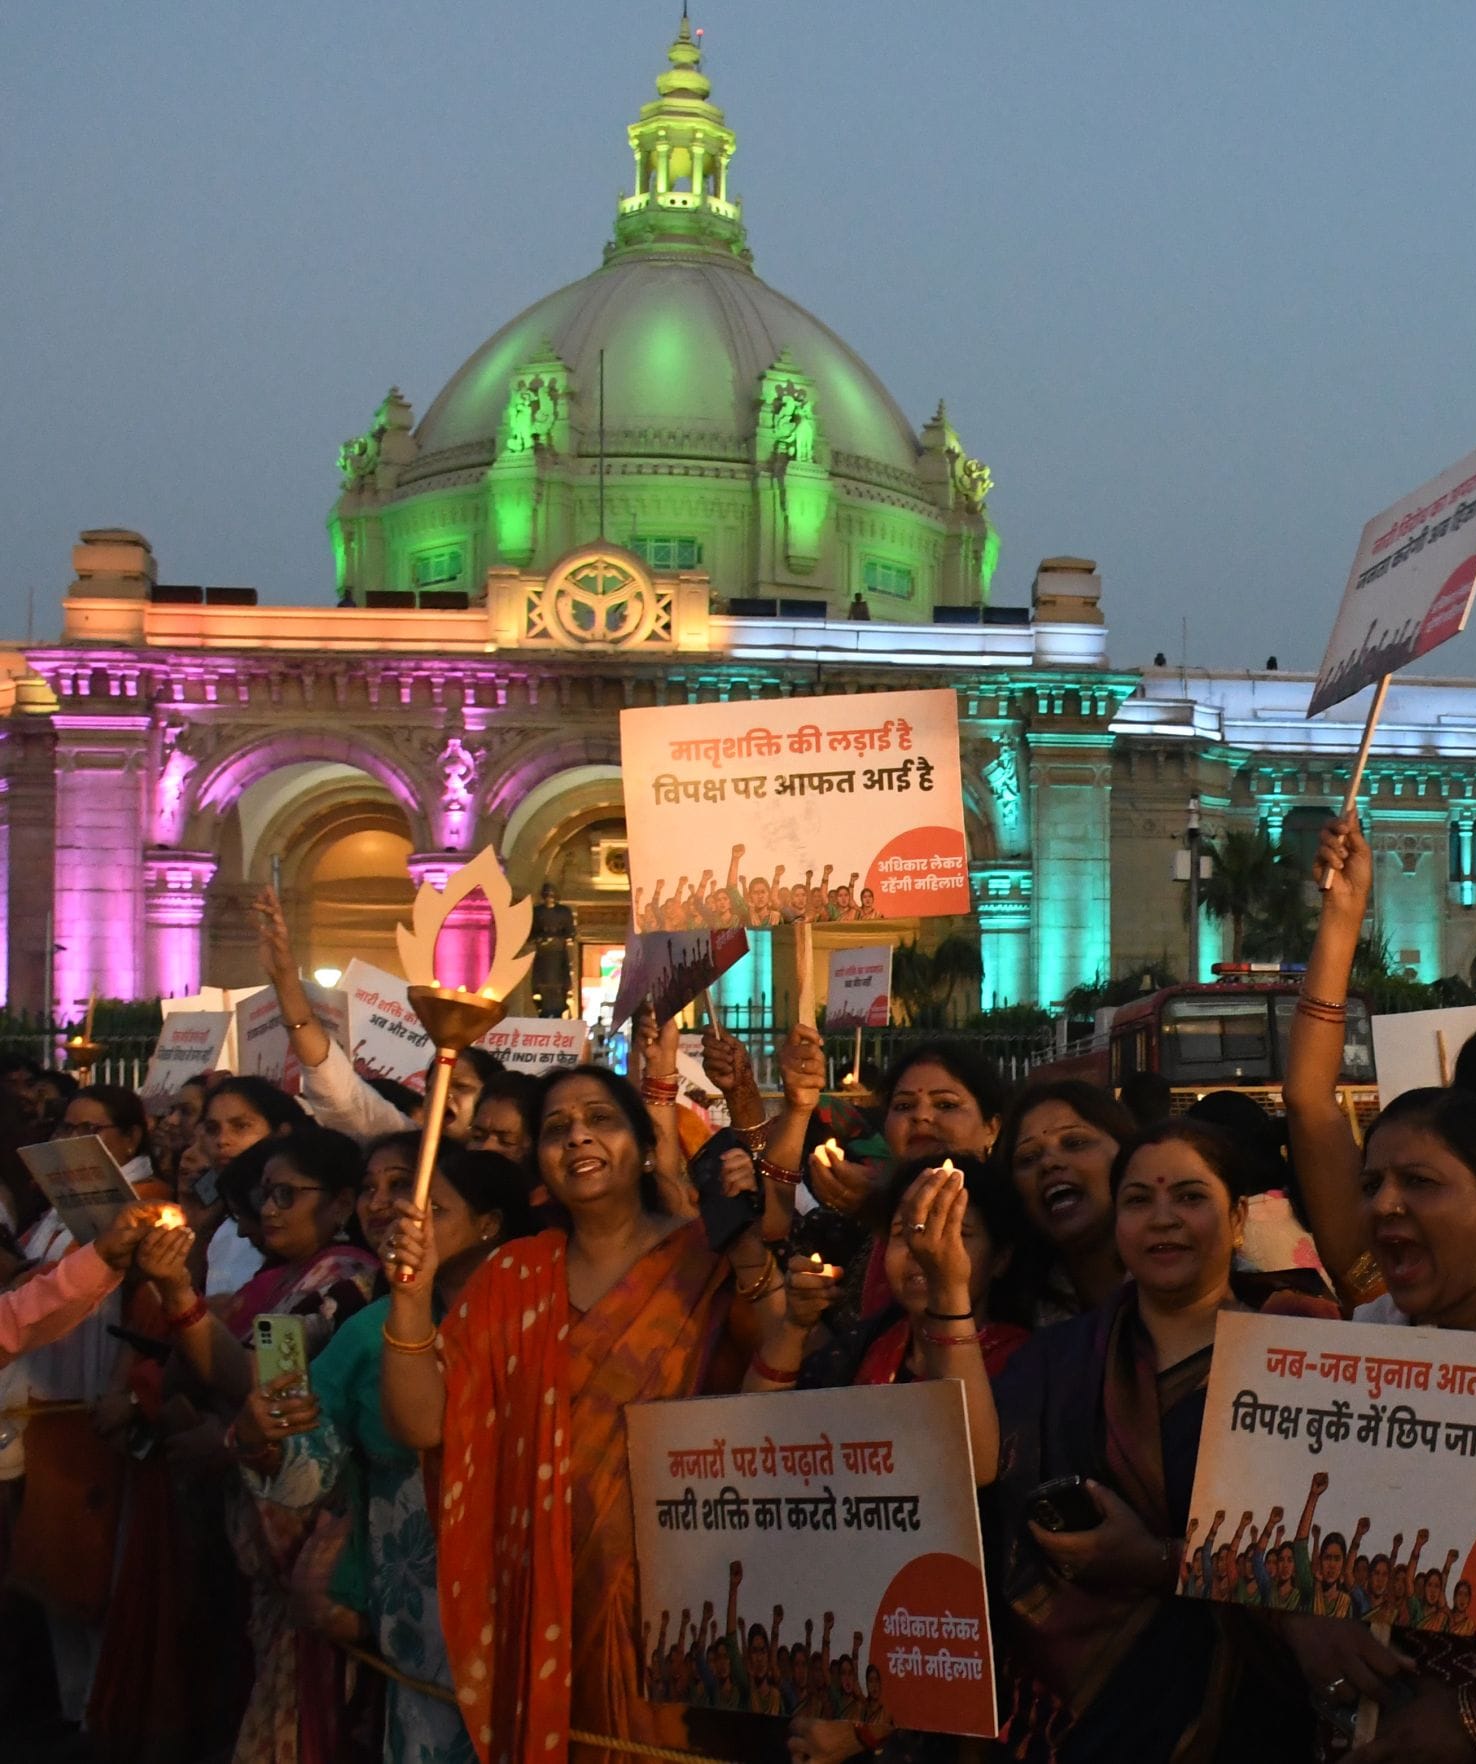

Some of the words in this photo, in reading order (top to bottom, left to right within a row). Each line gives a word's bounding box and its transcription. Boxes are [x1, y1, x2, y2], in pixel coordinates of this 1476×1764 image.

[669, 728, 782, 768] मातृशक्ति
[787, 725, 822, 754] की
[827, 720, 894, 758] लड़ाई
[895, 718, 913, 751] है
[652, 774, 726, 805] विपक्ष
[730, 777, 767, 799] पर
[774, 769, 855, 796] आफत
[862, 759, 914, 792] आई
[915, 757, 935, 791] है
[877, 857, 929, 873] अधिकार
[929, 855, 963, 871] लेकर
[880, 875, 913, 894] रहेंगी
[913, 871, 965, 890] महिलाएं
[1266, 1348, 1359, 1384] जब-जब
[1365, 1356, 1432, 1399] चुनाव
[1230, 1389, 1302, 1438] विपक्ष
[1356, 1405, 1387, 1447] में
[1387, 1406, 1440, 1452] छिप
[667, 1438, 727, 1480] मजारों
[731, 1447, 758, 1477] पर
[760, 1436, 777, 1477] ये
[840, 1440, 895, 1476] चादर
[656, 1487, 698, 1531] नारी
[702, 1486, 750, 1531] शक्ति
[753, 1498, 782, 1531] का
[785, 1485, 838, 1531] करते
[842, 1495, 921, 1532] अनादर
[883, 1607, 940, 1637] अधिकार
[941, 1610, 980, 1642] लेकर
[887, 1645, 923, 1678] रहेंगी
[925, 1649, 983, 1681] महिलाएं
